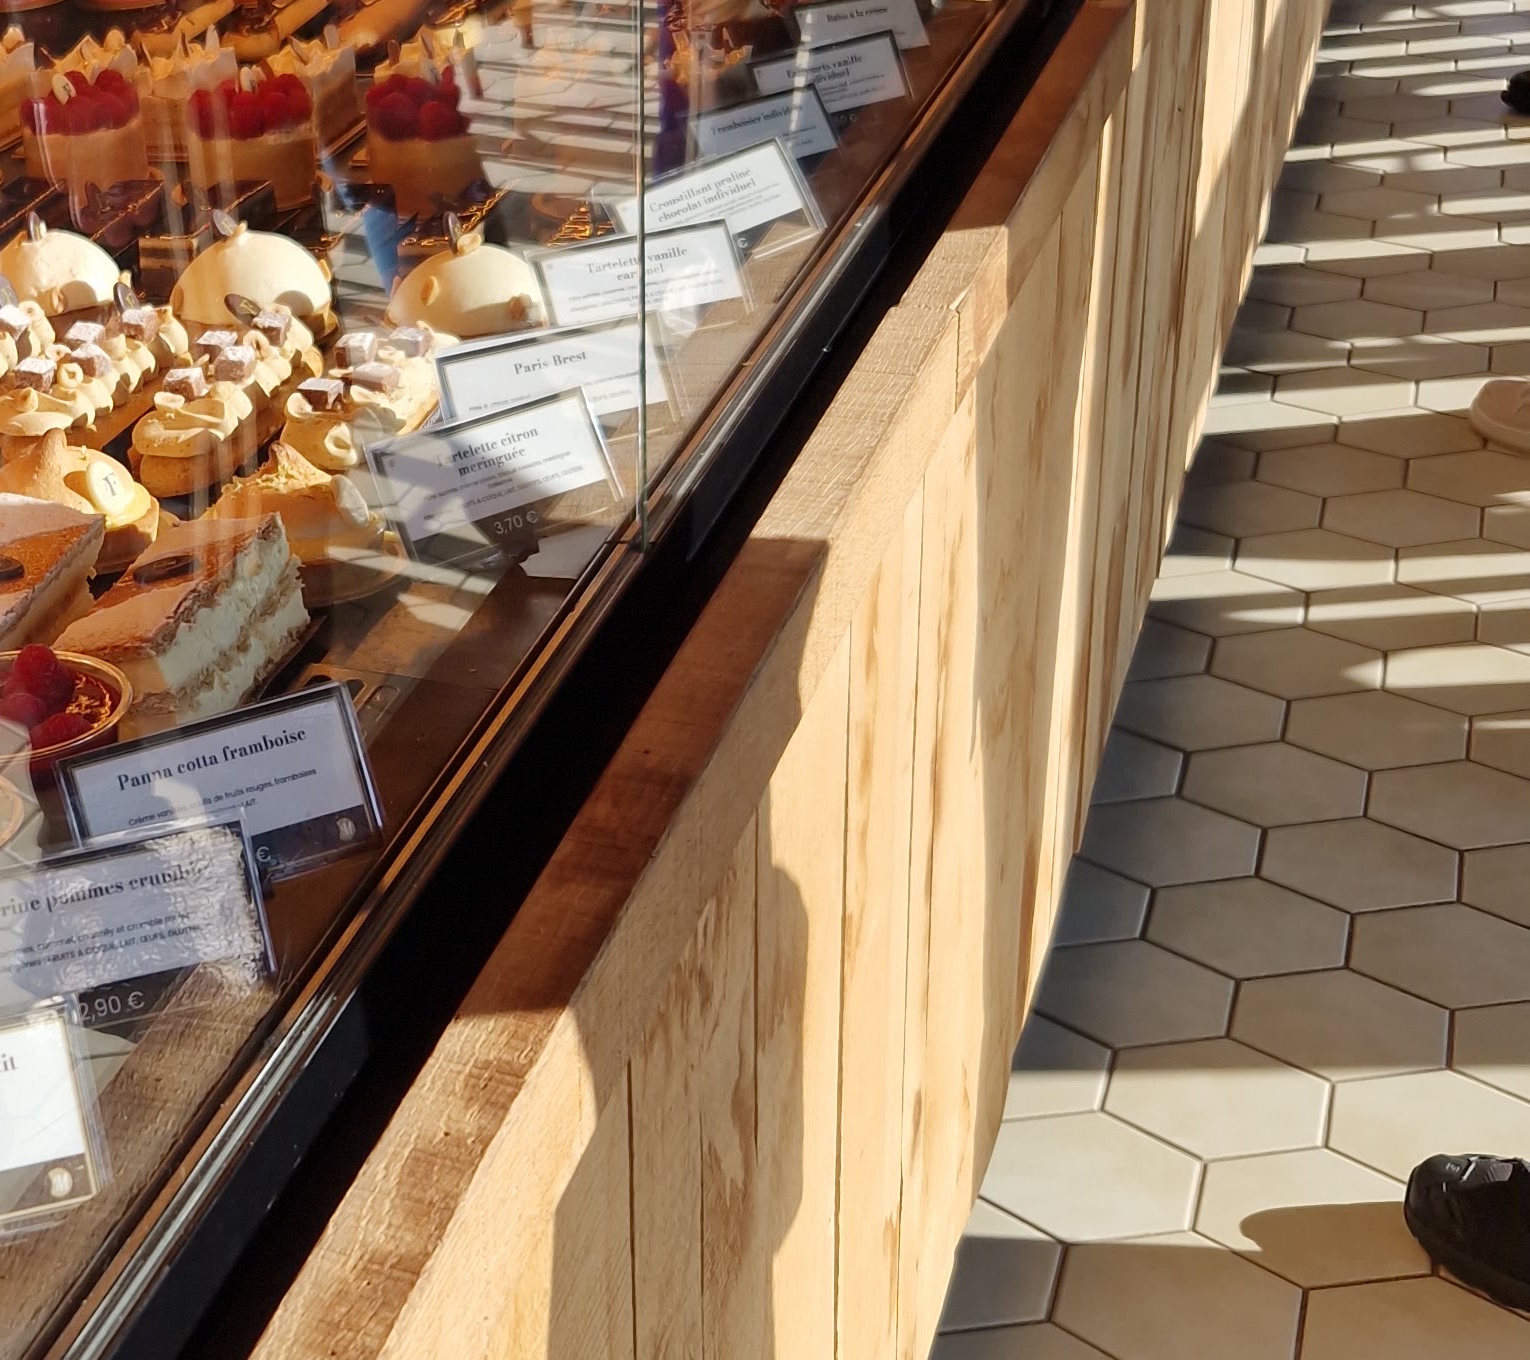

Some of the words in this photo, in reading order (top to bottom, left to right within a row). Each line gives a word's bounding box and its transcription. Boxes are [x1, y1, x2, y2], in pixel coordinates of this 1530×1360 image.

[649, 182, 712, 214] Croustillant
[713, 167, 752, 190] praliné
[658, 199, 703, 224] chocolat
[703, 178, 757, 206] individuel
[646, 246, 689, 263] vanille
[513, 358, 550, 376] Paris
[552, 351, 588, 368] Brest
[434, 439, 499, 468] Tartelette
[501, 426, 539, 449] citron
[457, 446, 527, 478] meringuée
[102, 472, 118, 497] F
[493, 516, 523, 536] 3,70
[526, 510, 540, 525] €
[117, 767, 174, 792] Panna
[176, 751, 220, 776] cotta
[221, 727, 308, 764] framboise
[128, 812, 156, 827] Crème
[213, 794, 224, 803] de
[245, 779, 273, 795] rouges,
[273, 767, 318, 786] framboises
[254, 844, 272, 864] €
[79, 995, 123, 1023] 2,90
[127, 991, 147, 1010] €
